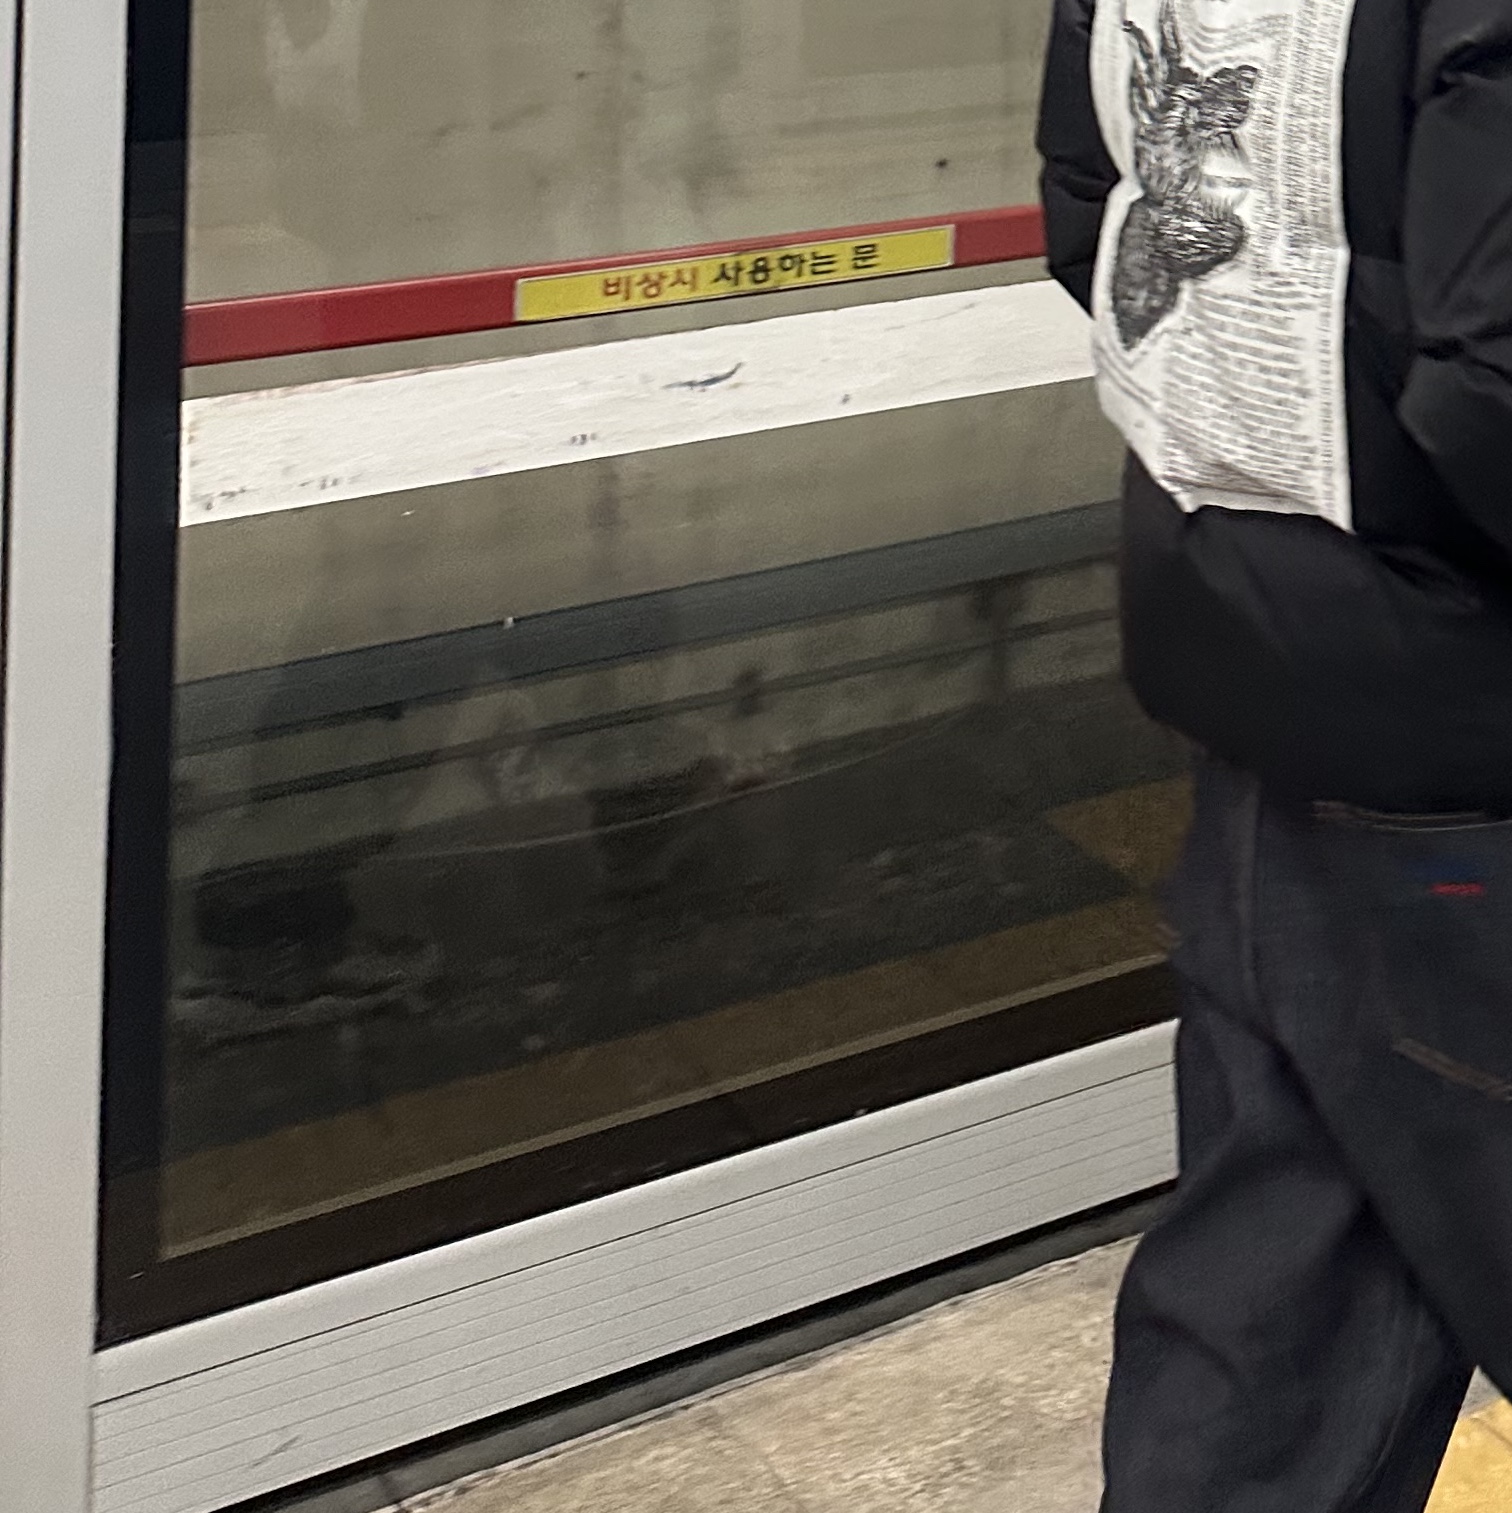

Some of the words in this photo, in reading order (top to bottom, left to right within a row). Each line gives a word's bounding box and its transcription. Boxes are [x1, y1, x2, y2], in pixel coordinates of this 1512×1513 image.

[602, 267, 697, 301] 비상시
[713, 251, 837, 286] 사용하는
[852, 243, 879, 270] 문
